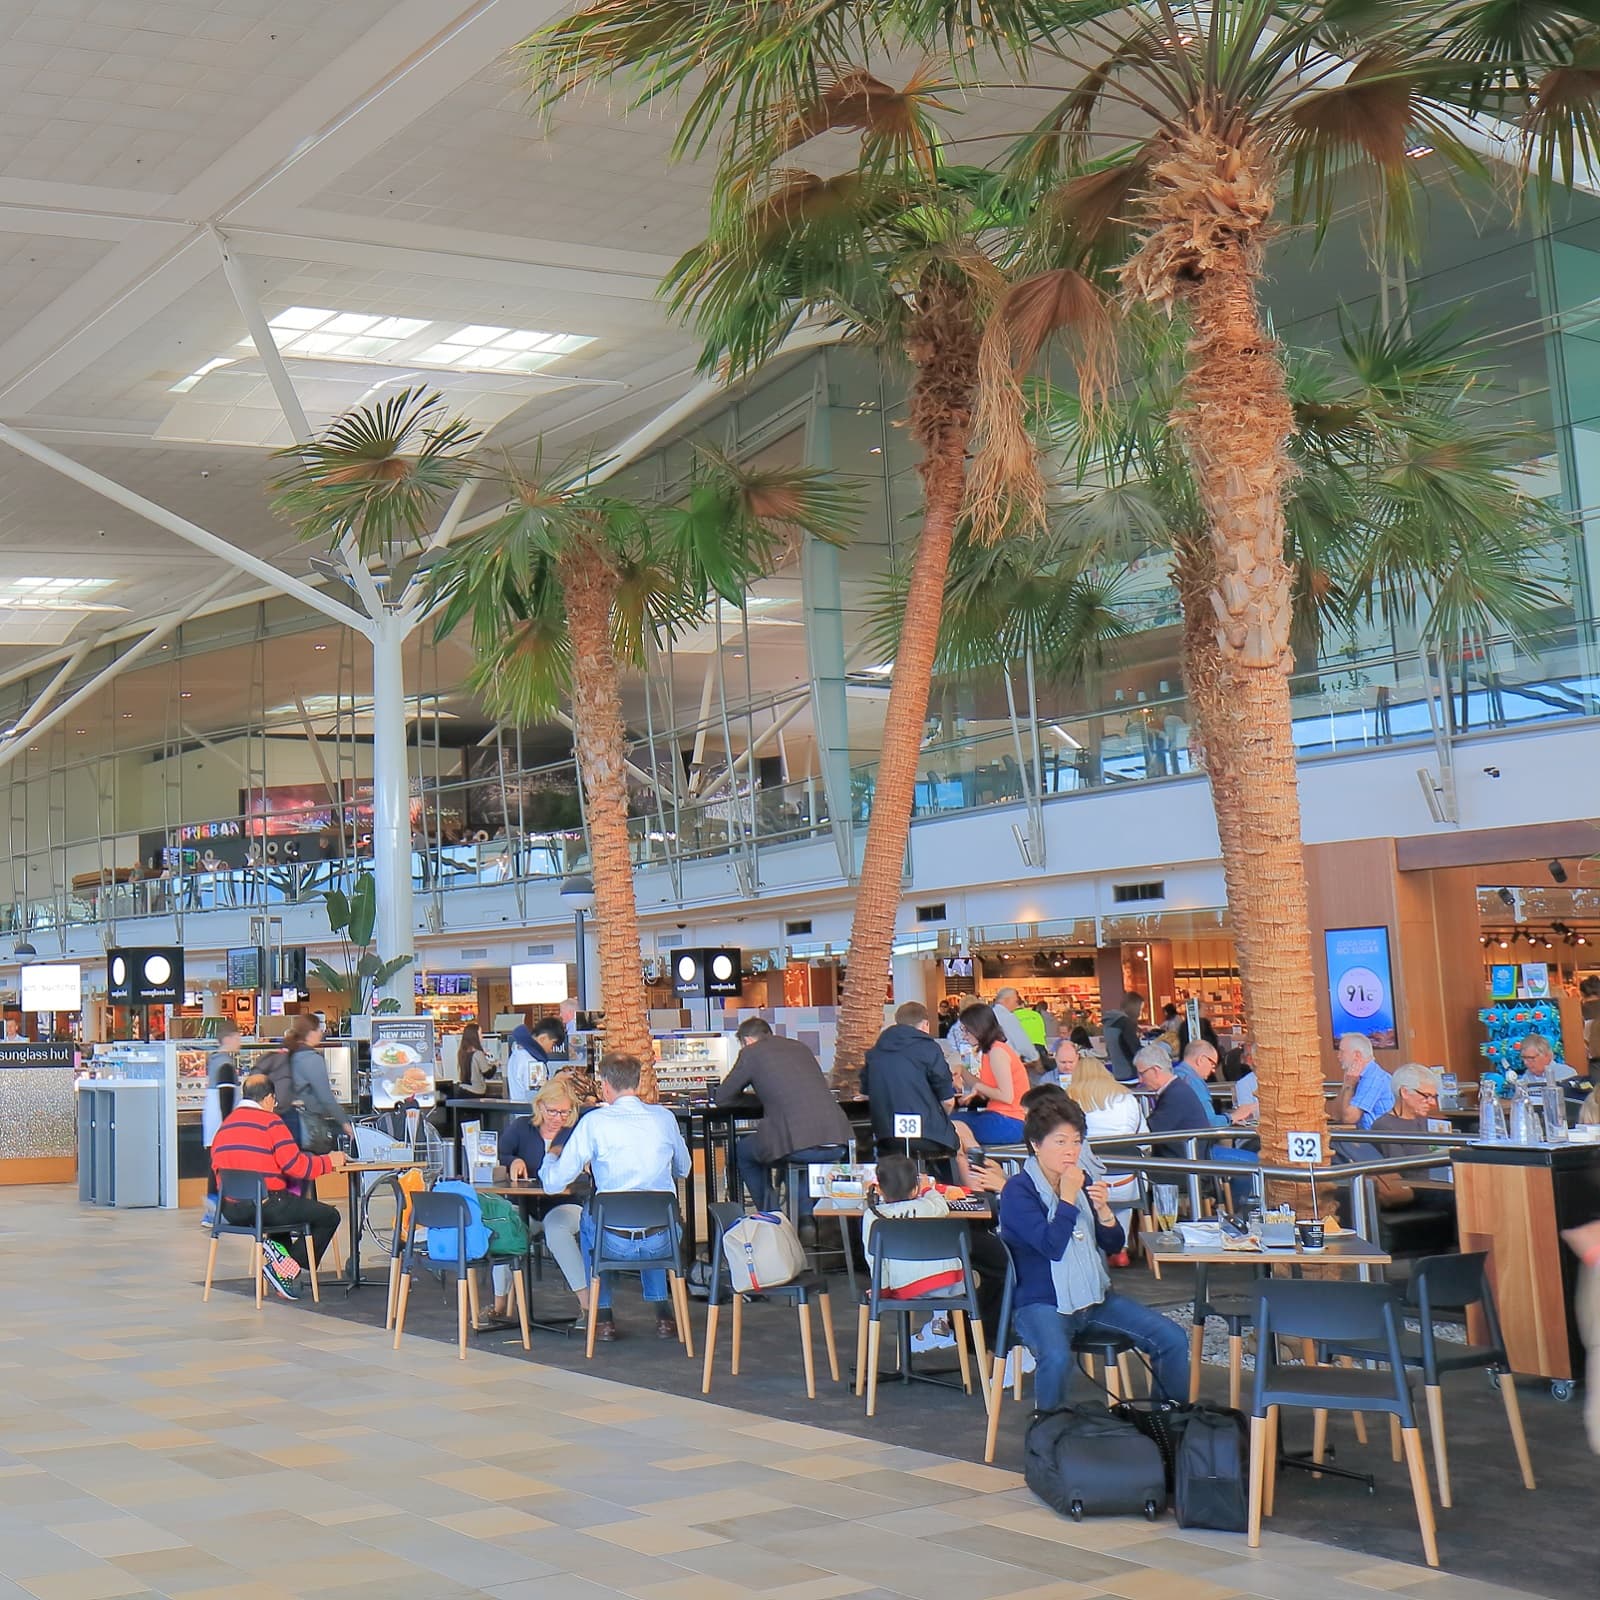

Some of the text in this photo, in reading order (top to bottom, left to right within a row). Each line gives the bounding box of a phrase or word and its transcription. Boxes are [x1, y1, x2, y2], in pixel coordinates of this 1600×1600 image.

[379, 1030, 426, 1039] NEW MENU
[0, 1047, 69, 1063] sunglass hut
[899, 1118, 917, 1134] 38
[1294, 1137, 1316, 1157] 32
